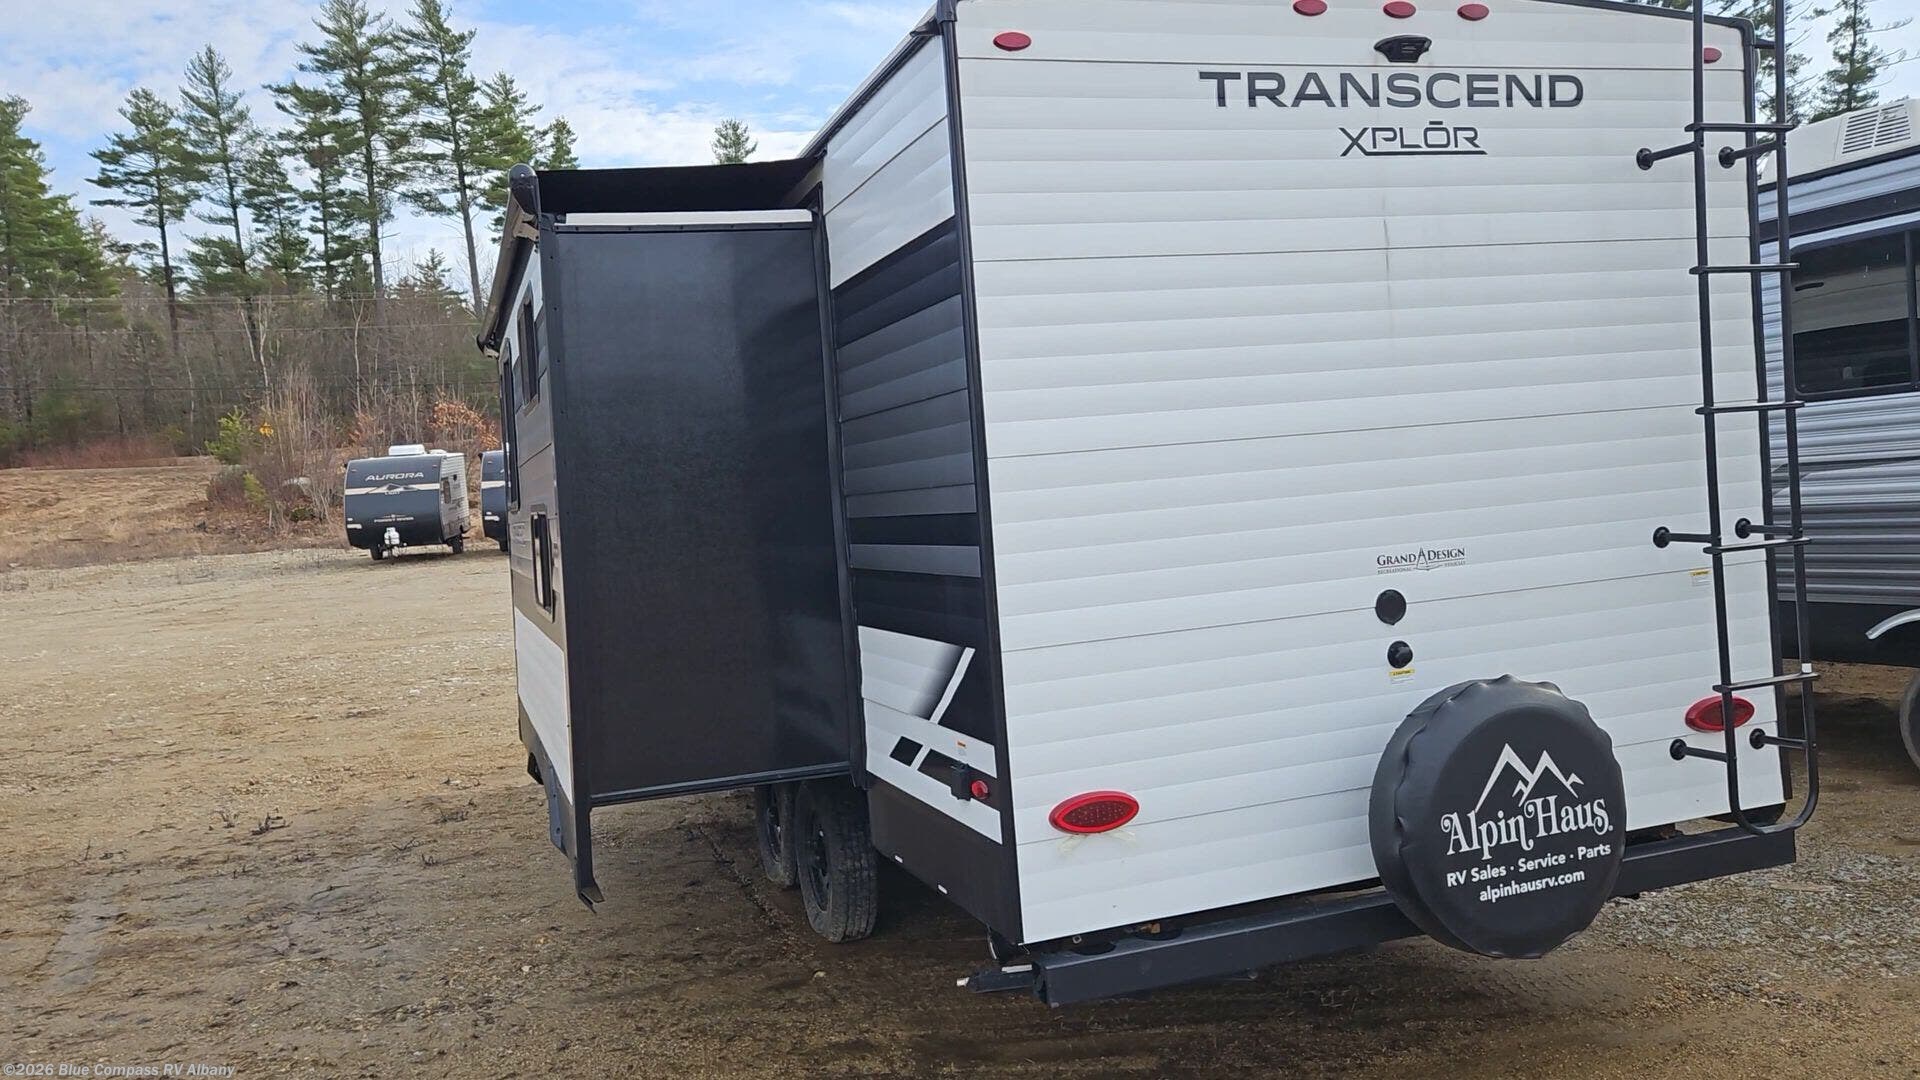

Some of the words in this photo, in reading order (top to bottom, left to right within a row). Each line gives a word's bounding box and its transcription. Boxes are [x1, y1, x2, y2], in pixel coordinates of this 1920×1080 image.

[1199, 71, 1584, 109] TRANSCEND
[365, 471, 424, 481] AURORA
[1440, 809, 1535, 860] Alpin
[1446, 870, 1467, 888] RV
[1470, 864, 1507, 883] Sales
[1517, 853, 1567, 873] Service
[1577, 843, 1612, 860] Parts
[1479, 870, 1586, 903] alpinhausrv.com
